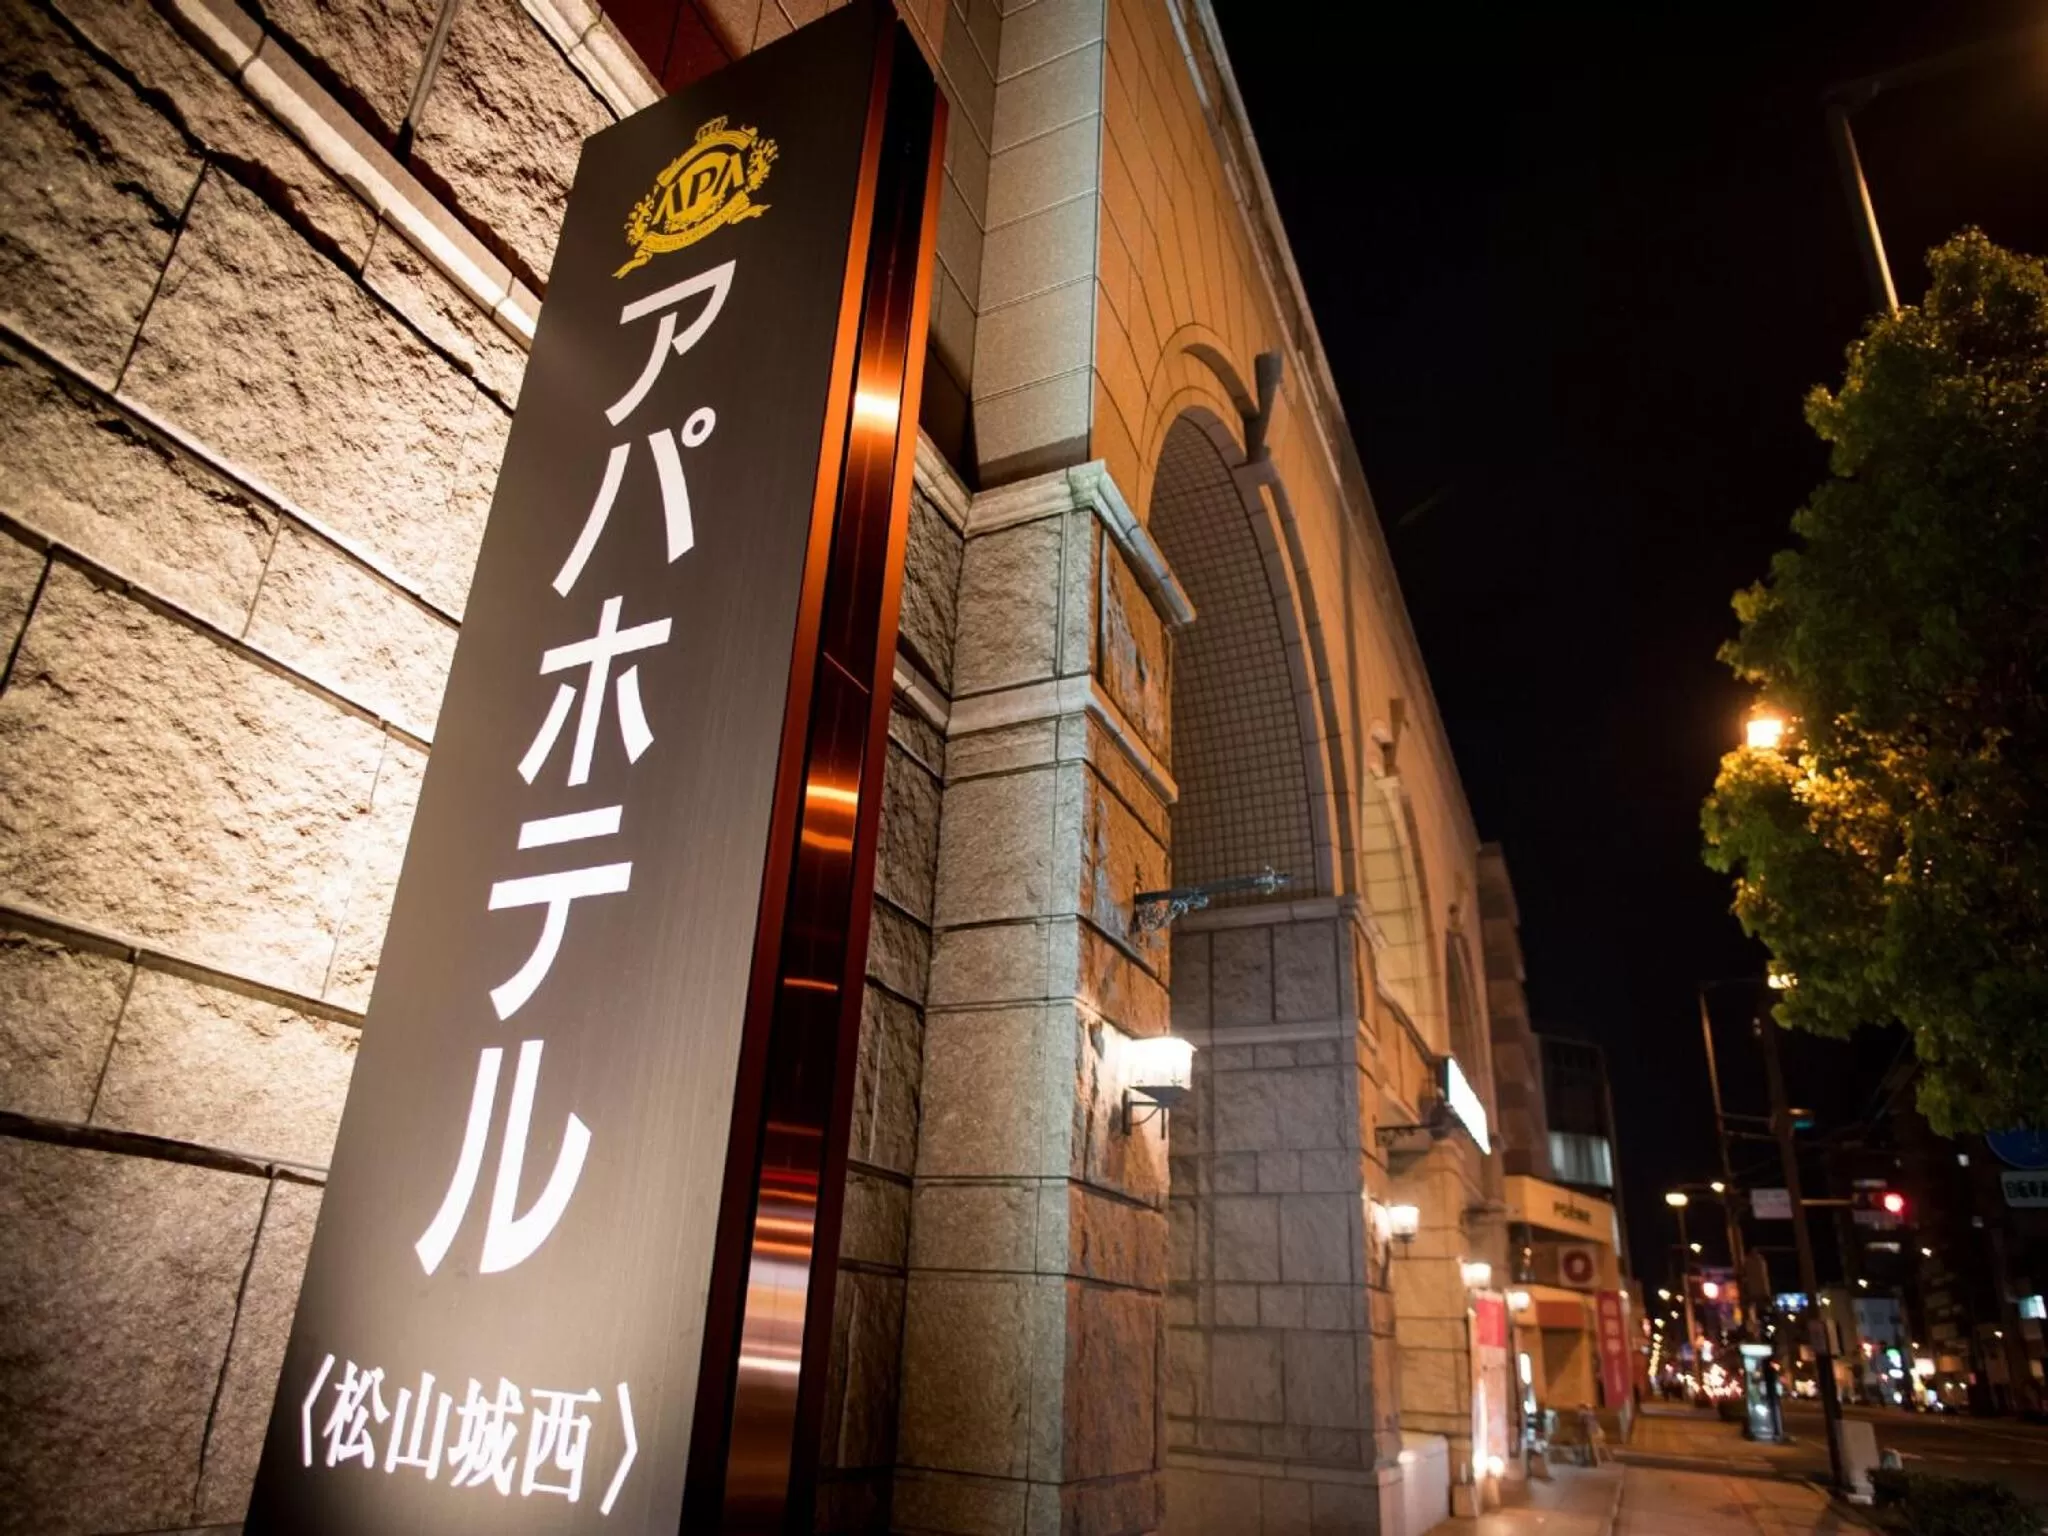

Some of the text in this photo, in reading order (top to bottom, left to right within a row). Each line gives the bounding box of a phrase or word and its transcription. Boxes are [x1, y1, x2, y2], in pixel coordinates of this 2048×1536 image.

[650, 151, 745, 226] APA
[414, 258, 738, 1277] アパホテル
